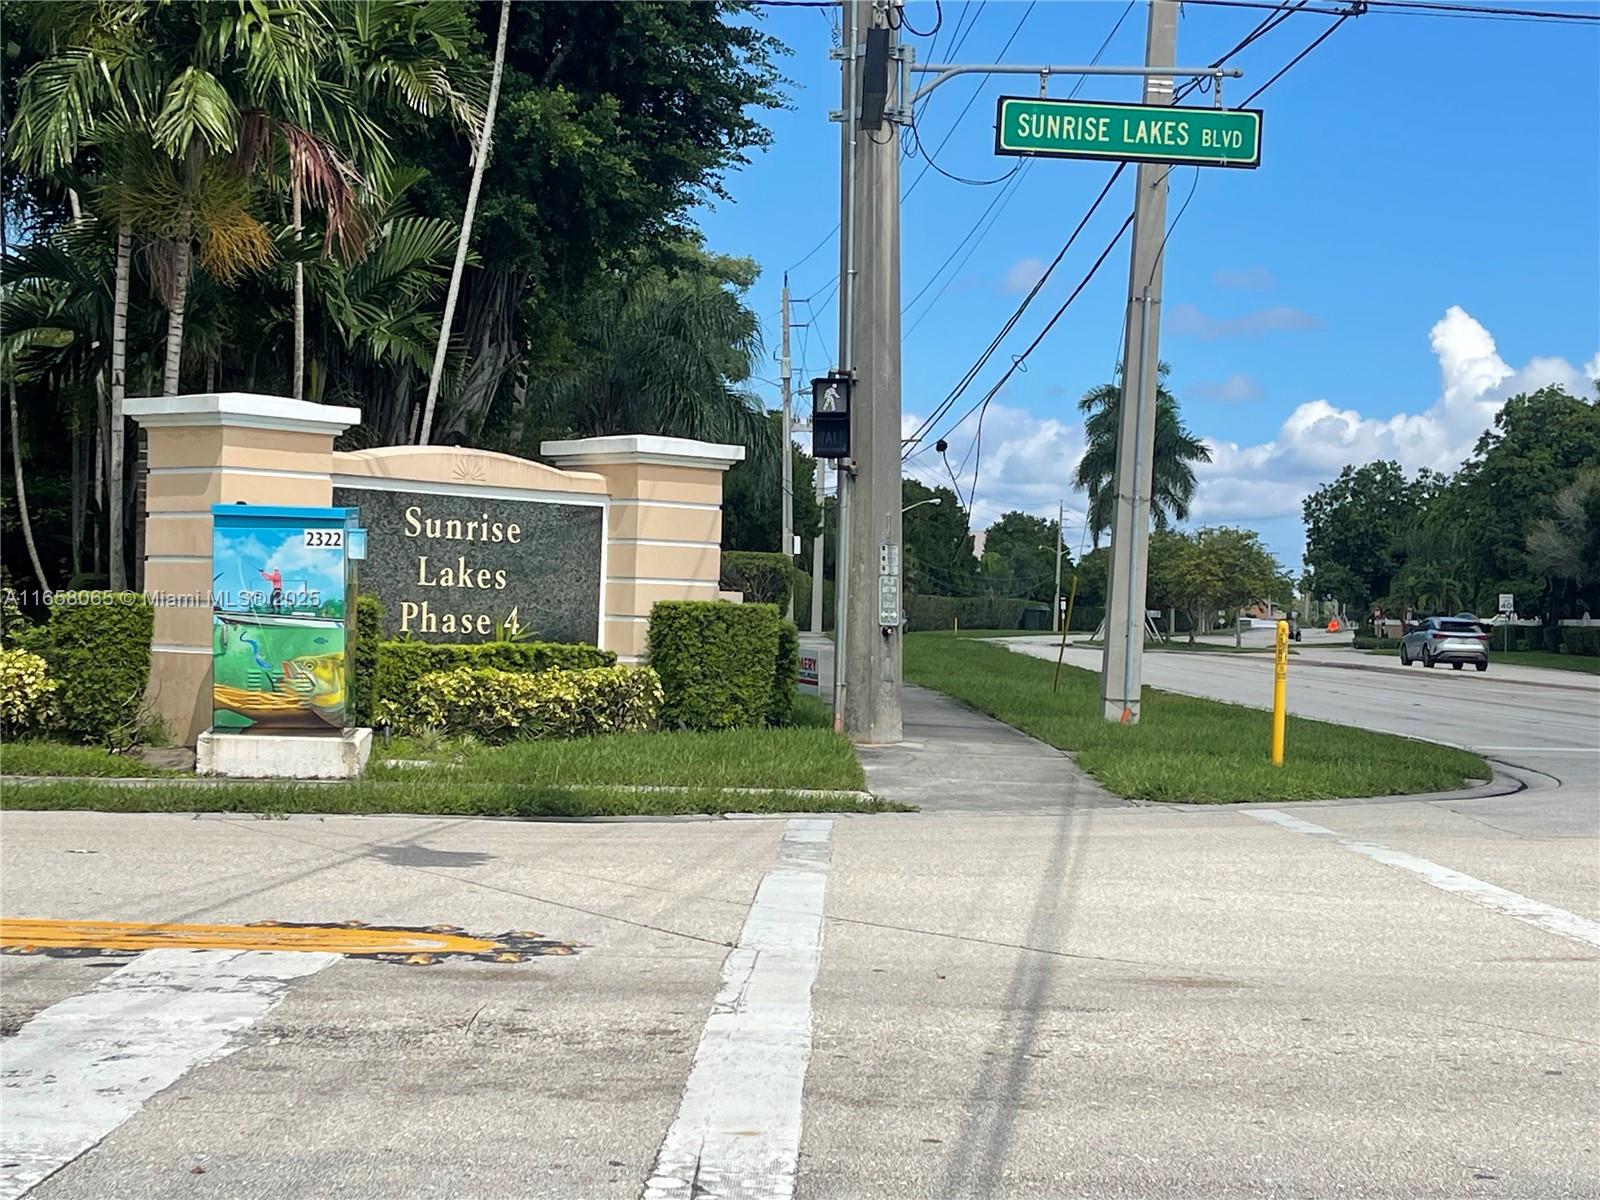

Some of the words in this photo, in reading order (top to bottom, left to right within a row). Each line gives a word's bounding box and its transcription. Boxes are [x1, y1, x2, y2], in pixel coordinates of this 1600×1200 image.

[1017, 113, 1110, 143] SUNRISE
[1123, 119, 1190, 146] LAKES
[1201, 129, 1242, 149] BLVD
[306, 531, 342, 547] 2322
[405, 506, 522, 544] Sunrise
[417, 556, 507, 590] Lakes
[400, 601, 491, 634] Phase
[503, 606, 520, 634] 4
